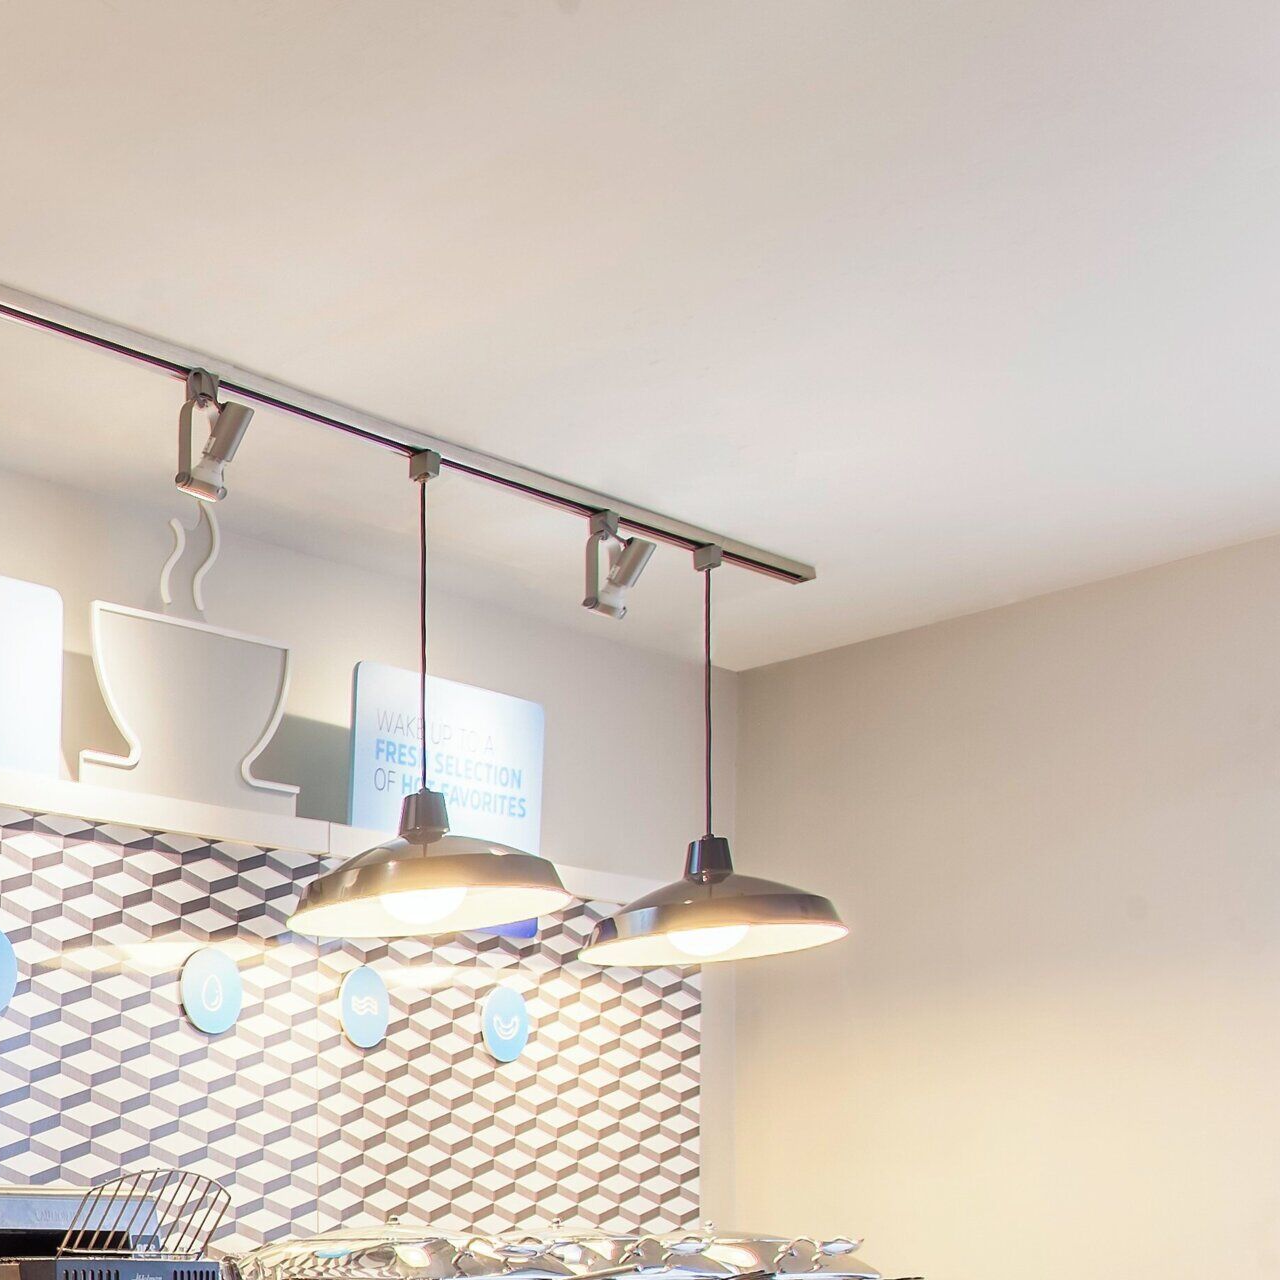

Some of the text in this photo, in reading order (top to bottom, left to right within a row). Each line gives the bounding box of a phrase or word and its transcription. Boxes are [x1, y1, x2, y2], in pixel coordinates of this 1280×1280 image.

[374, 768, 396, 792] OF
[375, 739, 522, 790] FRES SELECTION
